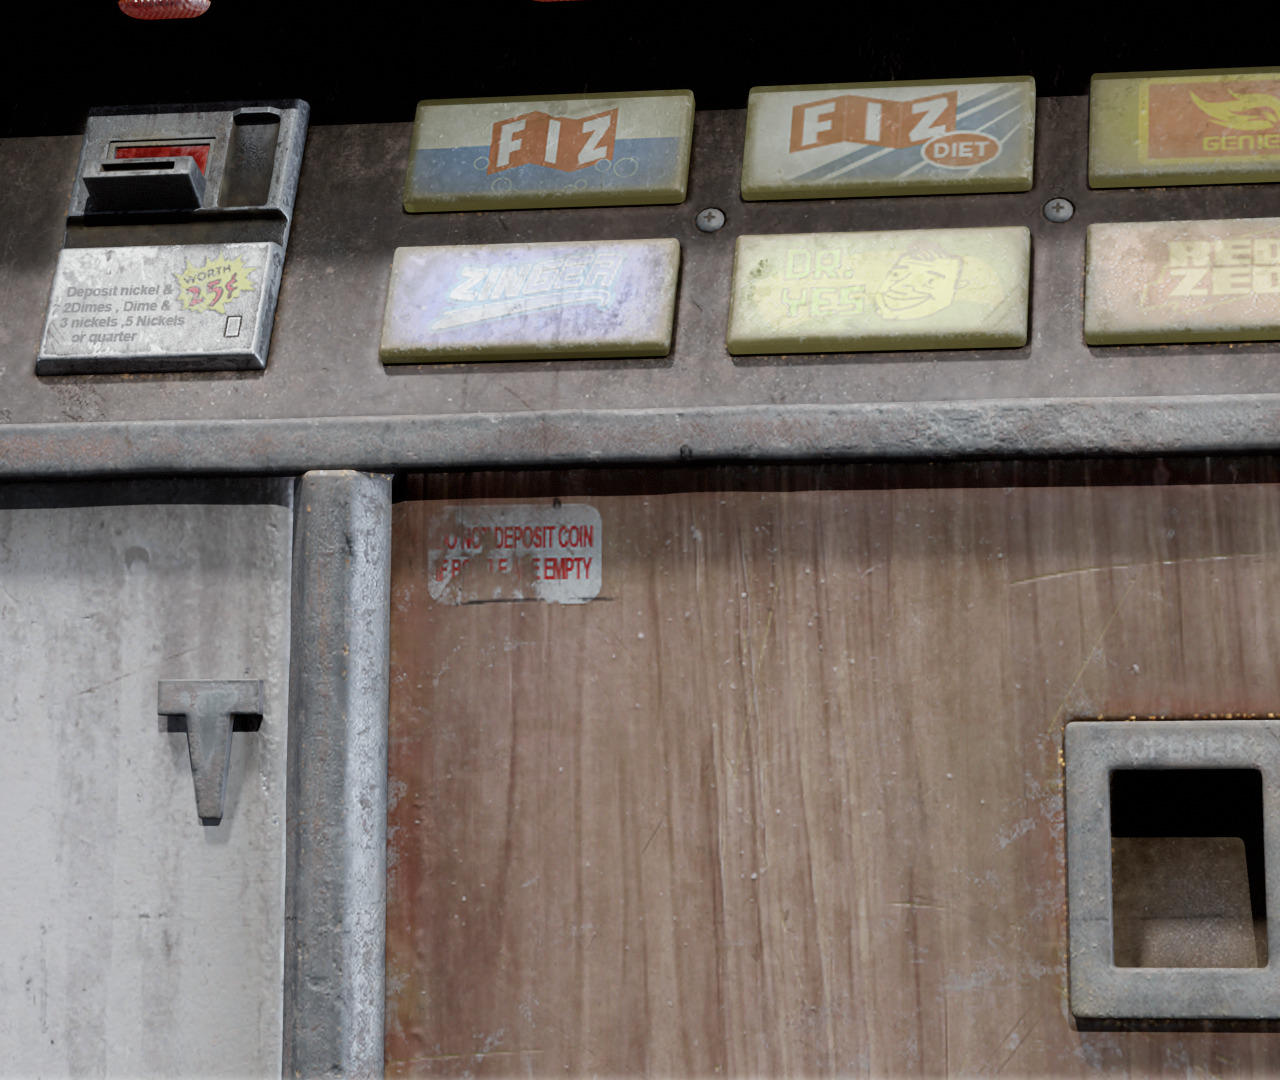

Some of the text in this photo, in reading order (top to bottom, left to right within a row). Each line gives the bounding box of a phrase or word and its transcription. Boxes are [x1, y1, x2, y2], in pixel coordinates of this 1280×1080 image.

[801, 97, 949, 147] FIZ
[496, 114, 611, 167] FIZ
[933, 141, 990, 159] DIET
[1202, 133, 1280, 152] GENIE
[183, 264, 232, 284] WORTH
[67, 284, 173, 299] Deposit nickel &
[123, 301, 158, 312] Dime
[160, 300, 170, 311] &
[60, 317, 68, 328] 3
[71, 316, 118, 328] nickels
[136, 315, 185, 327] Nickels
[71, 331, 138, 345] or quarter
[494, 526, 556, 549] DEPOSIT
[558, 525, 594, 548] COIN
[544, 557, 593, 580] EMPTY
[1126, 735, 1246, 759] OPENER
